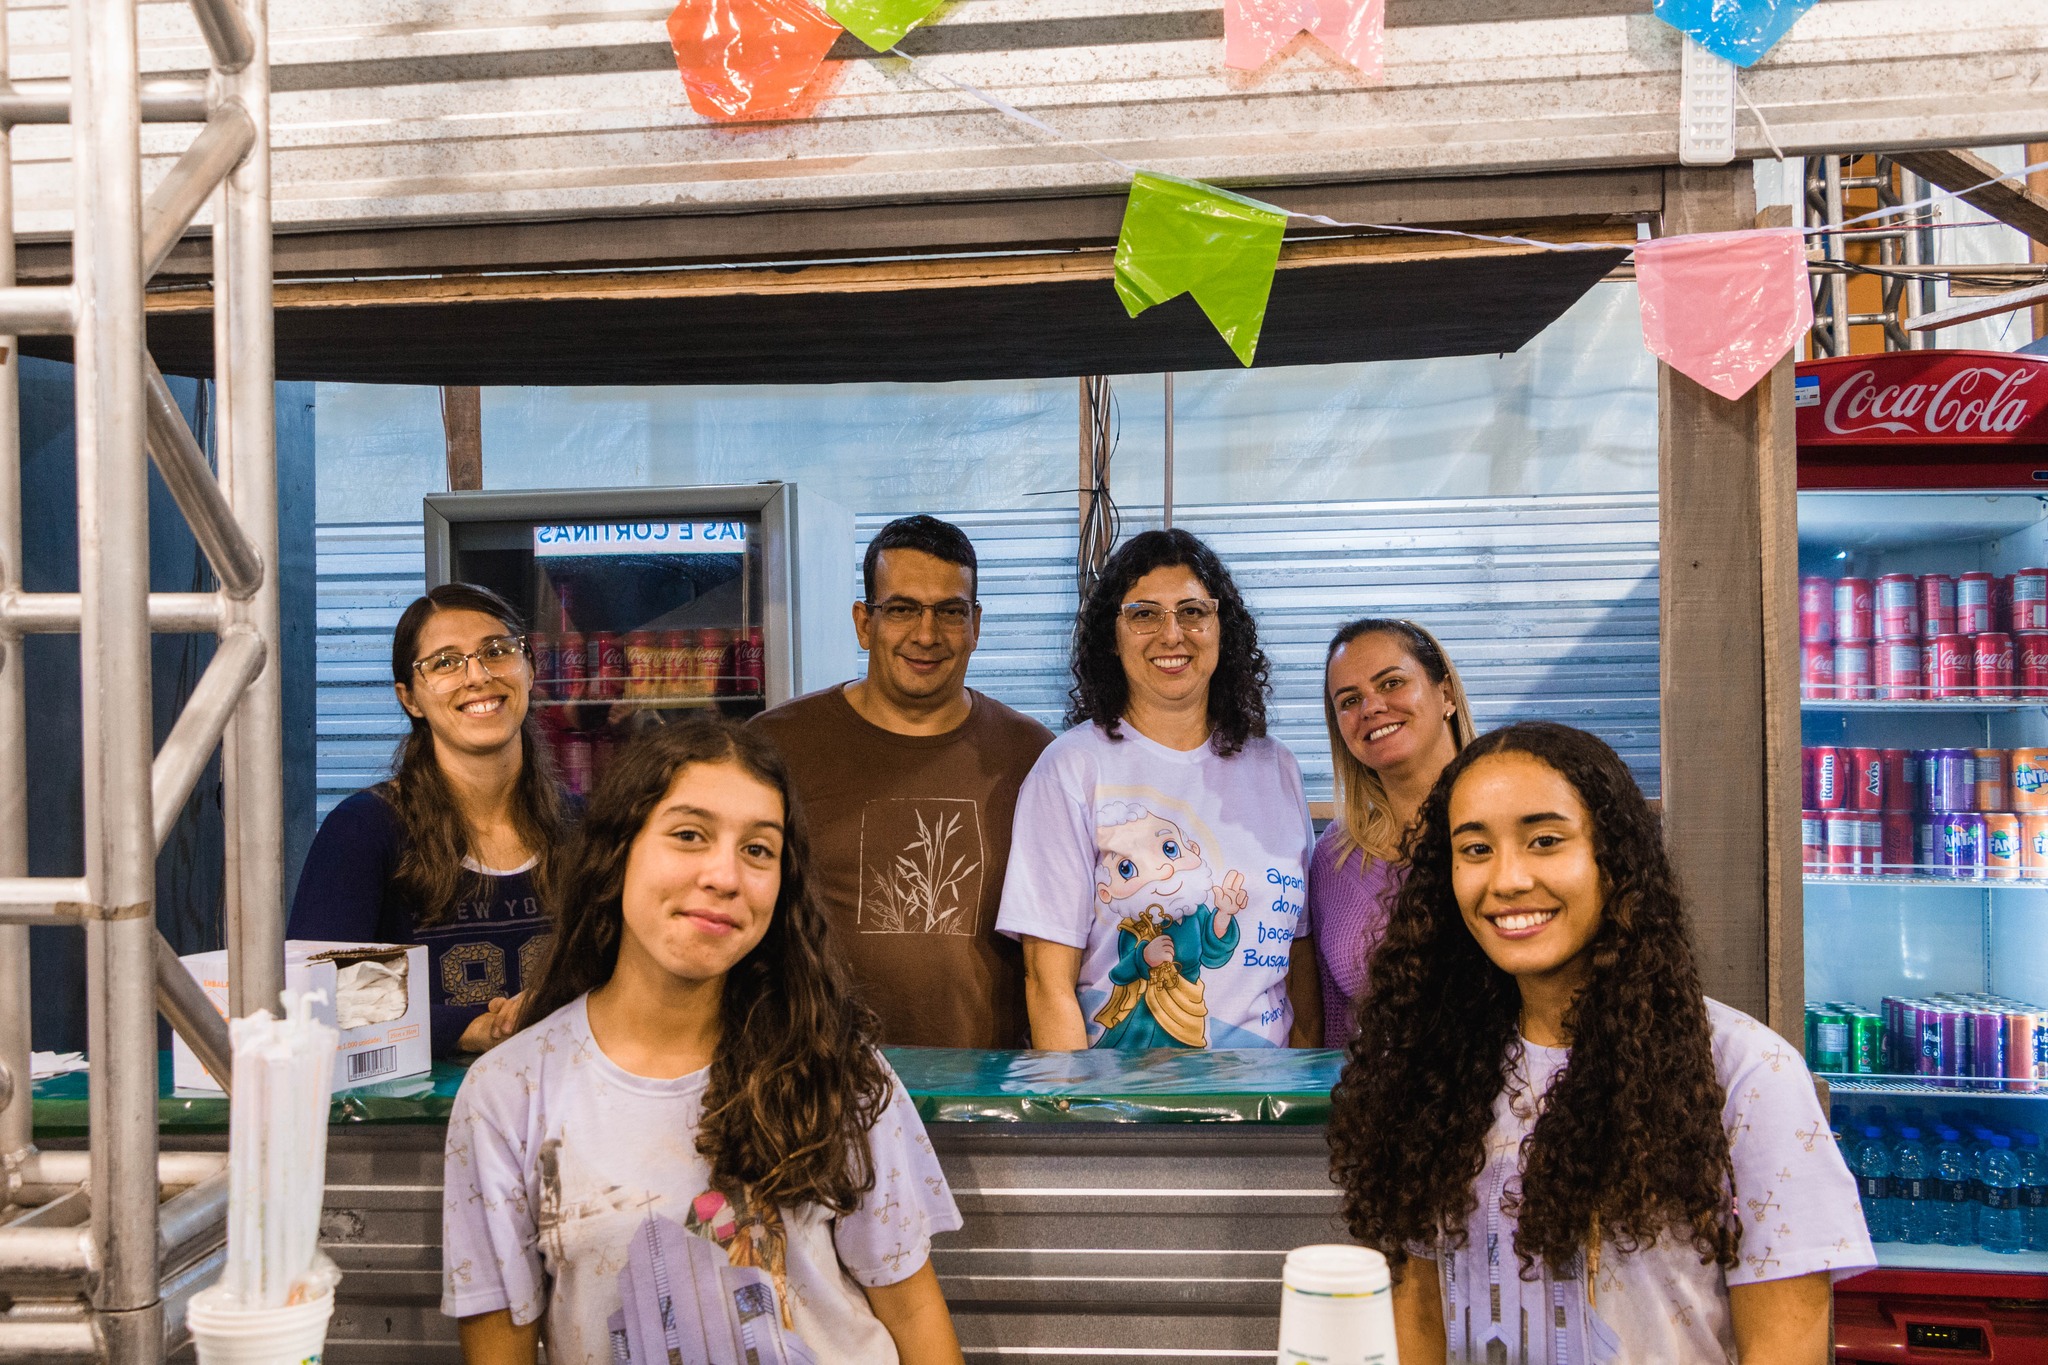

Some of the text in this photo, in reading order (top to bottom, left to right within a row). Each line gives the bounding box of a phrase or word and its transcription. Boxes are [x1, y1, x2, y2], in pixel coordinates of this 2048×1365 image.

[1824, 367, 2040, 435] Coca-Cola
[1820, 754, 1834, 800] Rainha
[1865, 761, 1880, 796] Avós
[457, 901, 491, 920] EW
[1272, 895, 1290, 913] do
